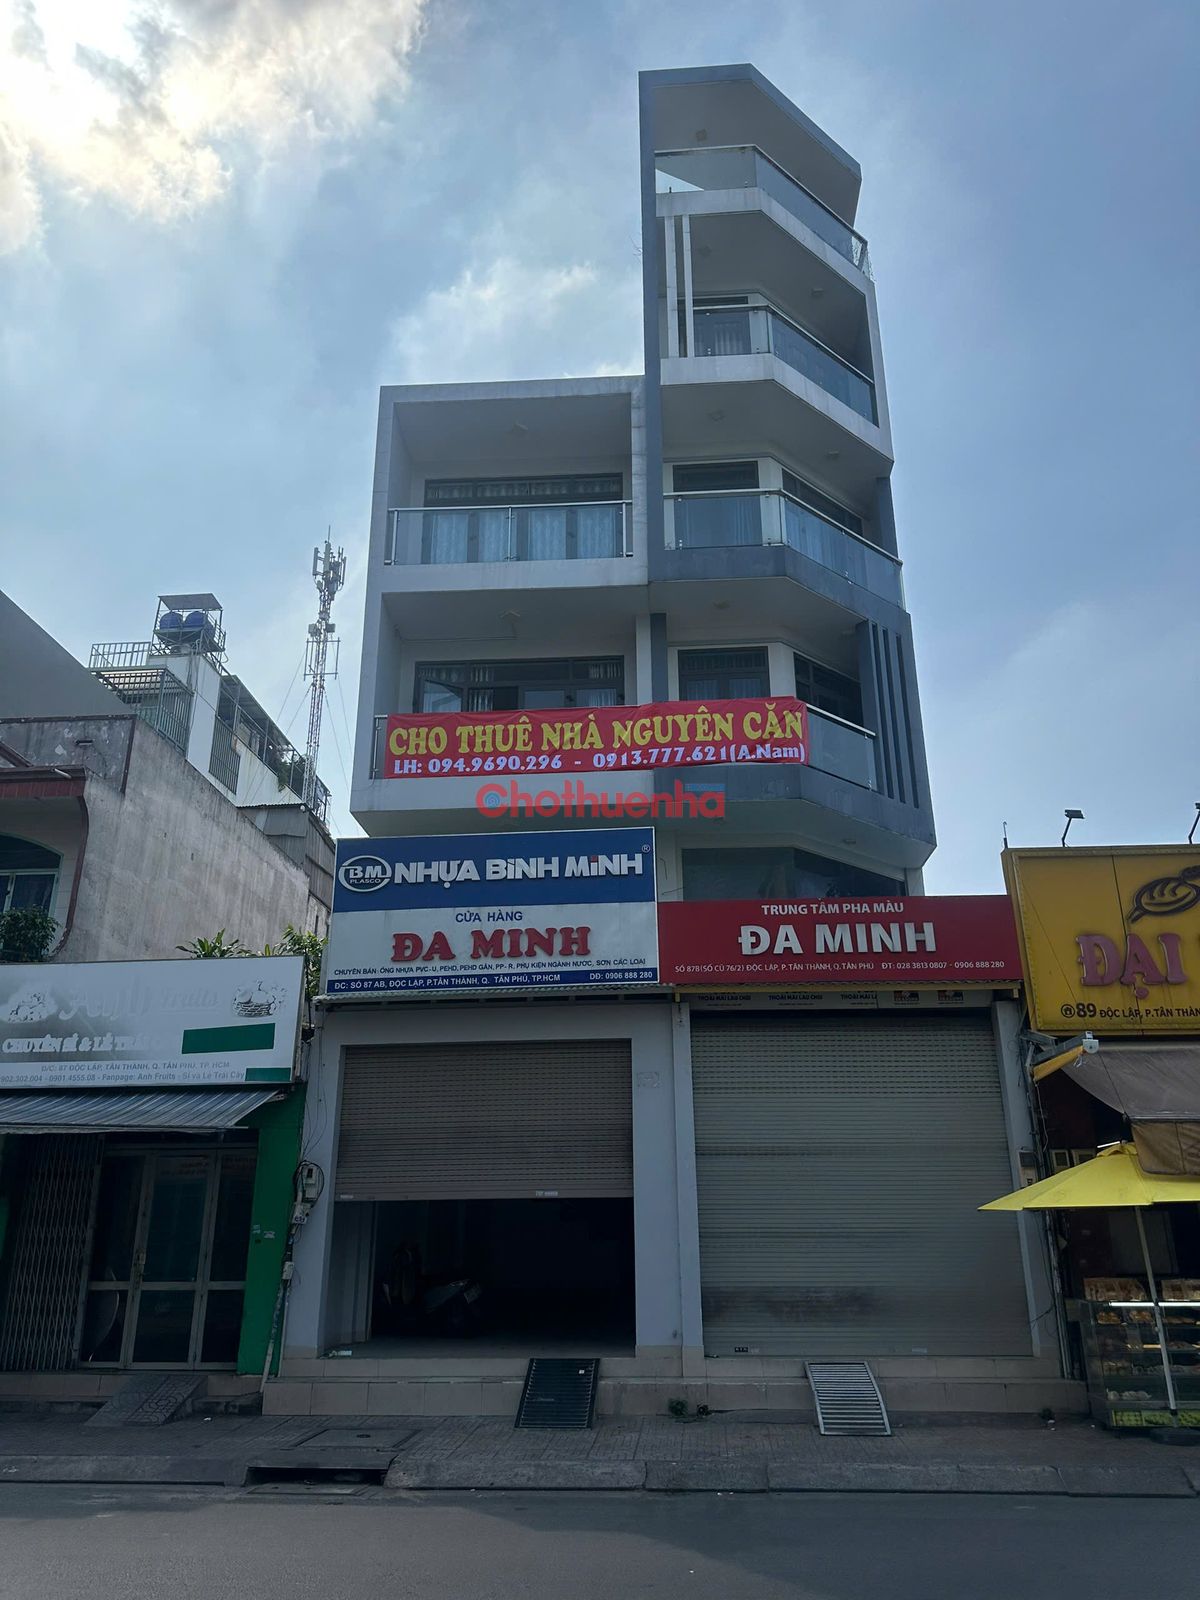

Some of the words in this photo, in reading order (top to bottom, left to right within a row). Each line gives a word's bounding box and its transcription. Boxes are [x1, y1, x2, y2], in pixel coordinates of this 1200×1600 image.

[389, 726, 448, 756] CHO
[455, 715, 533, 754] THUÊ
[541, 713, 605, 751] NHÀ
[612, 705, 734, 748] NGUYÊN
[742, 702, 803, 740] CĂN
[394, 759, 422, 774] LH:
[428, 754, 562, 773] 094.9690.296
[394, 859, 481, 889] NHỰA
[455, 910, 482, 923] CỬA
[487, 909, 523, 922] HÀNG
[761, 904, 808, 915] TRUNG
[810, 902, 839, 914] TÂM
[842, 903, 871, 914] PHA
[873, 900, 904, 913] MÀU
[390, 931, 456, 962] ĐA
[470, 926, 591, 959] MINH
[737, 924, 804, 956] ĐA
[815, 921, 937, 954] MINH
[334, 967, 362, 976] CHUYÊN
[379, 966, 395, 974] ỐNG
[396, 966, 414, 975] NHỰA
[516, 962, 530, 970] PHỤ
[548, 960, 571, 968] NGÀNH
[596, 958, 611, 966] SƠN
[613, 957, 628, 966] CÁC
[605, 972, 623, 980] 0906
[624, 971, 638, 979] 888
[639, 971, 653, 979] 280
[675, 963, 685, 973] SỐ
[746, 963, 763, 973] ĐỘC
[912, 961, 928, 969] 3813
[929, 961, 947, 969] 0807
[954, 961, 974, 969] 0906
[975, 960, 990, 968] 888
[991, 960, 1005, 968] 280
[1075, 932, 1188, 1000] ĐẠI
[350, 980, 362, 989] SỐ
[388, 979, 407, 989] ĐỘC
[481, 976, 490, 984] Q.
[494, 974, 510, 984] TÂN
[1076, 1002, 1097, 1018] 89
[1099, 1006, 1122, 1021] ĐỘC
[102, 1073, 136, 1082] Fanpage:
[138, 1072, 153, 1081] Anh
[154, 1071, 176, 1080] Fruits
